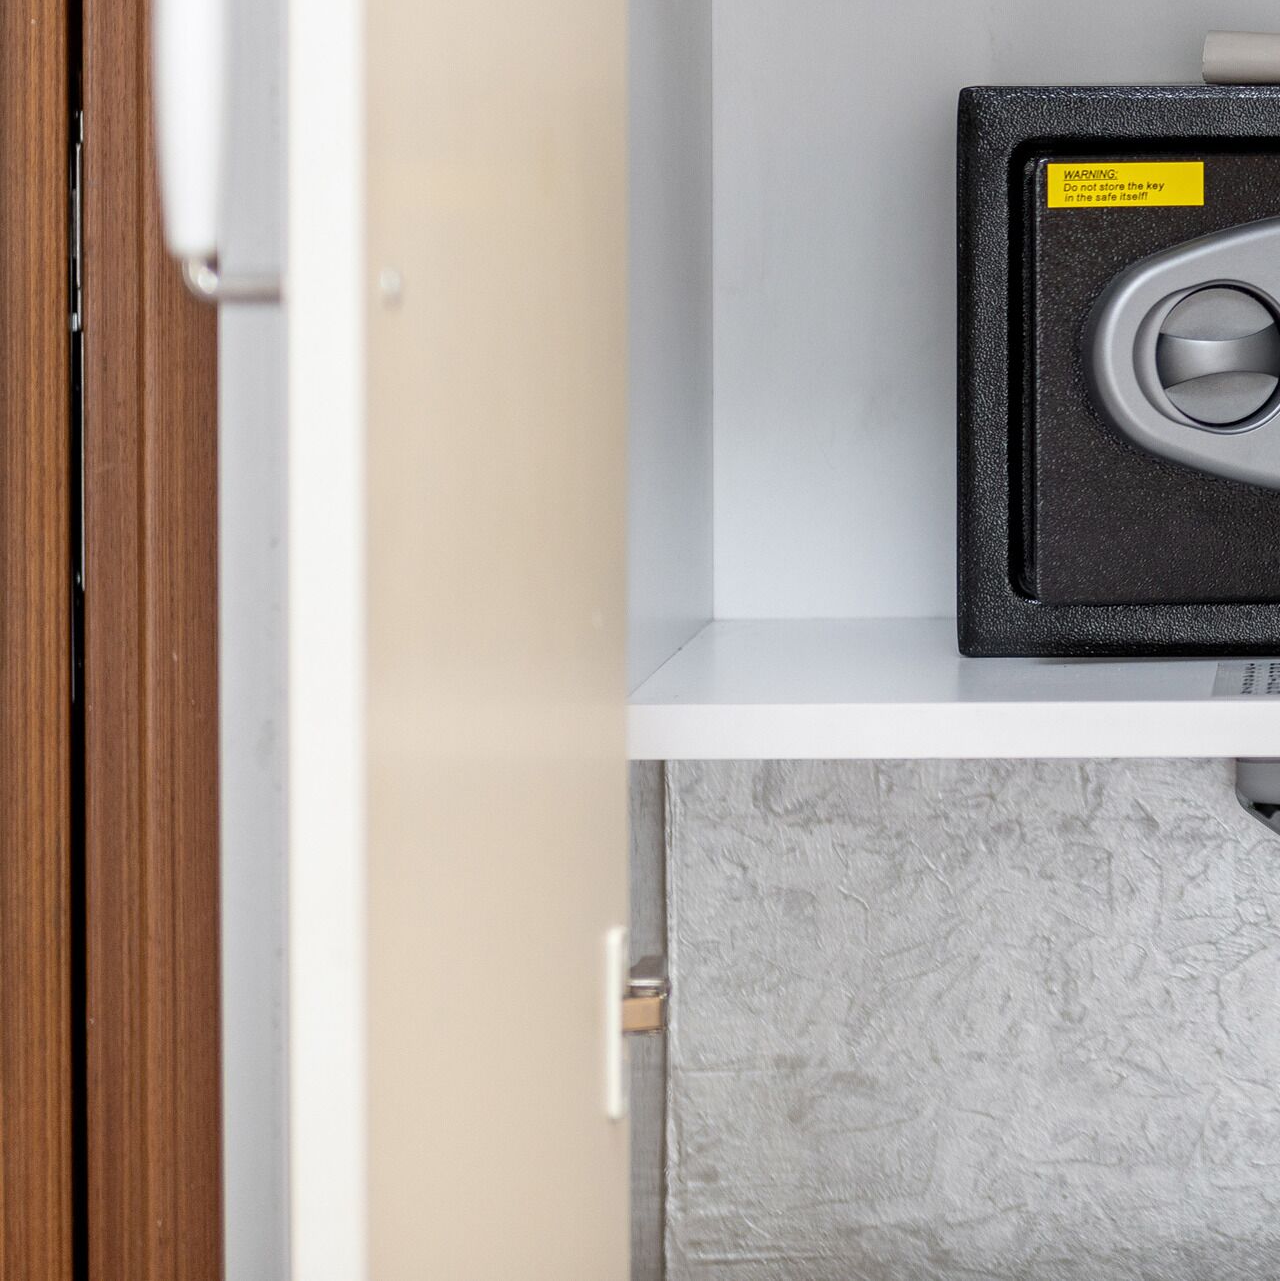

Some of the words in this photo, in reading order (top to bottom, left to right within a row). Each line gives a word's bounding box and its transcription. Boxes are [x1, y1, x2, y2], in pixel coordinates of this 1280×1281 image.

[1064, 183, 1078, 192] Do
[1080, 183, 1097, 191] not
[1099, 183, 1125, 191] store
[1128, 182, 1143, 190] the
[1146, 182, 1165, 191] key
[1065, 194, 1073, 202] in
[1076, 193, 1092, 202] the
[1095, 193, 1117, 202] safe
